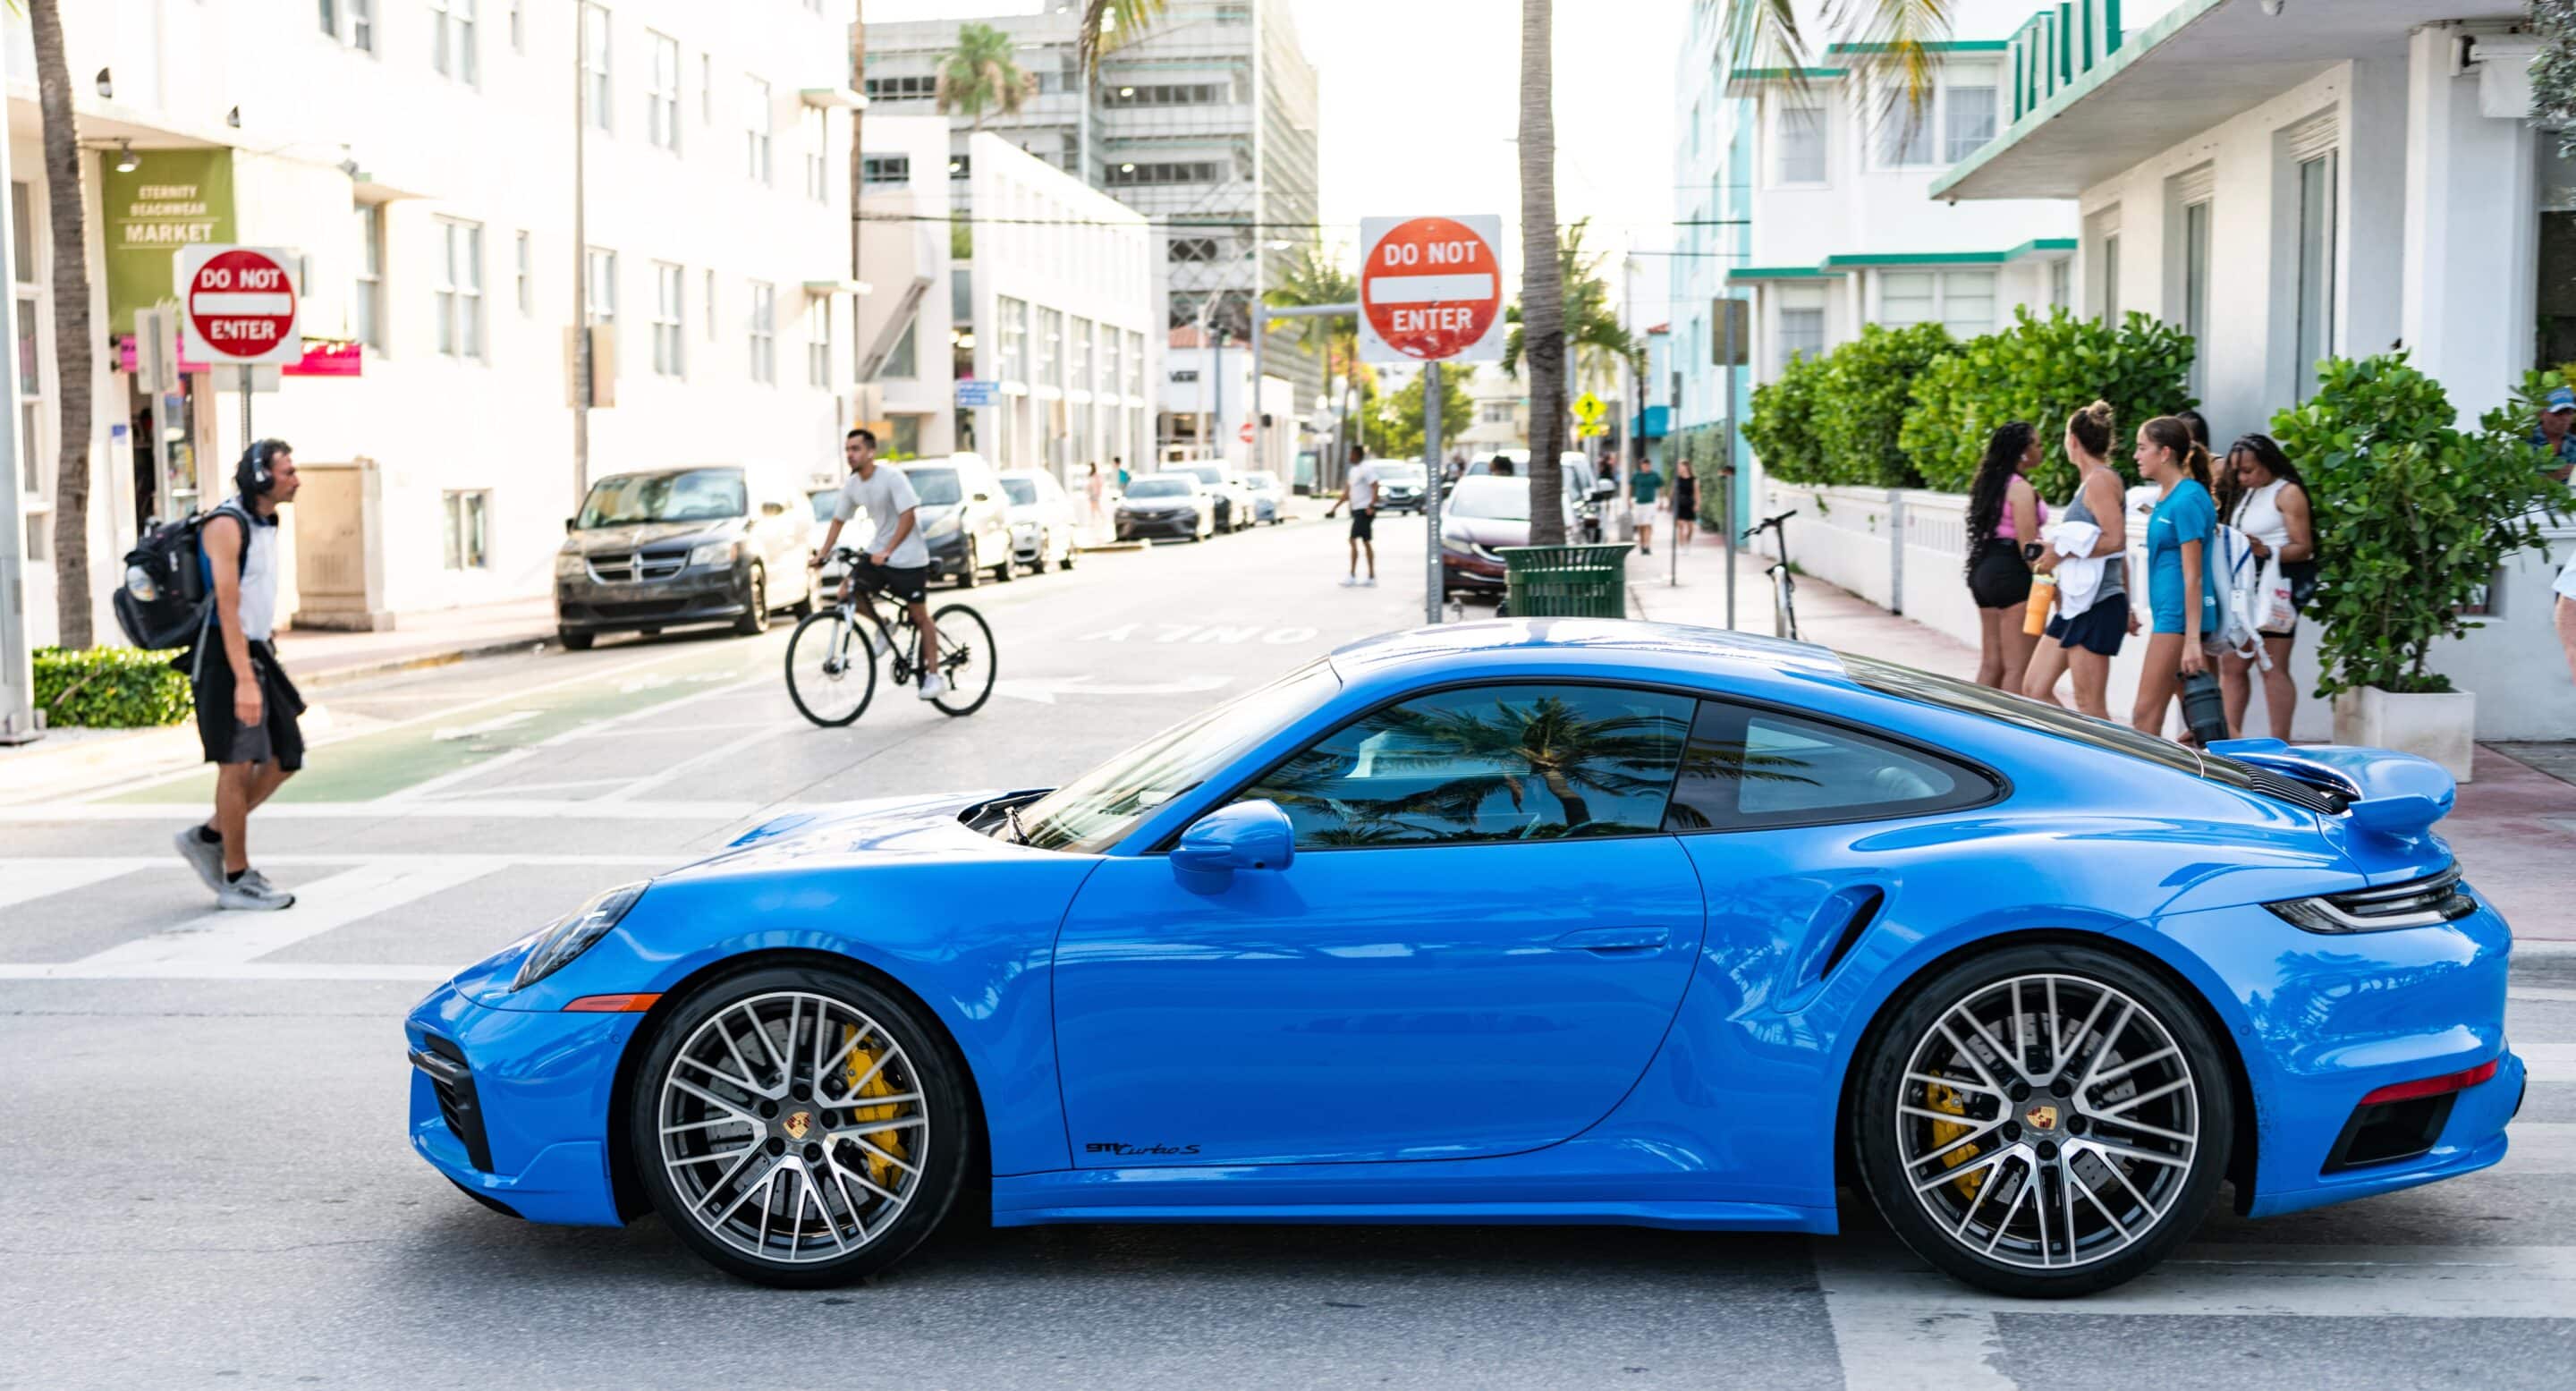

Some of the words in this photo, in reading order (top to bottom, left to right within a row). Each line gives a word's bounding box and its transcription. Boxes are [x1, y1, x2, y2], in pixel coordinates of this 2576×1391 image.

[138, 184, 198, 199] ETERNITY
[125, 223, 213, 242] MARKET
[1384, 243, 1419, 267] DO
[1428, 241, 1479, 264] NOT
[200, 268, 231, 289] DO
[239, 268, 281, 289] NOT
[210, 319, 276, 340] ENTER
[1393, 308, 1473, 332] ENTER
[1179, 1144, 1201, 1155] S
